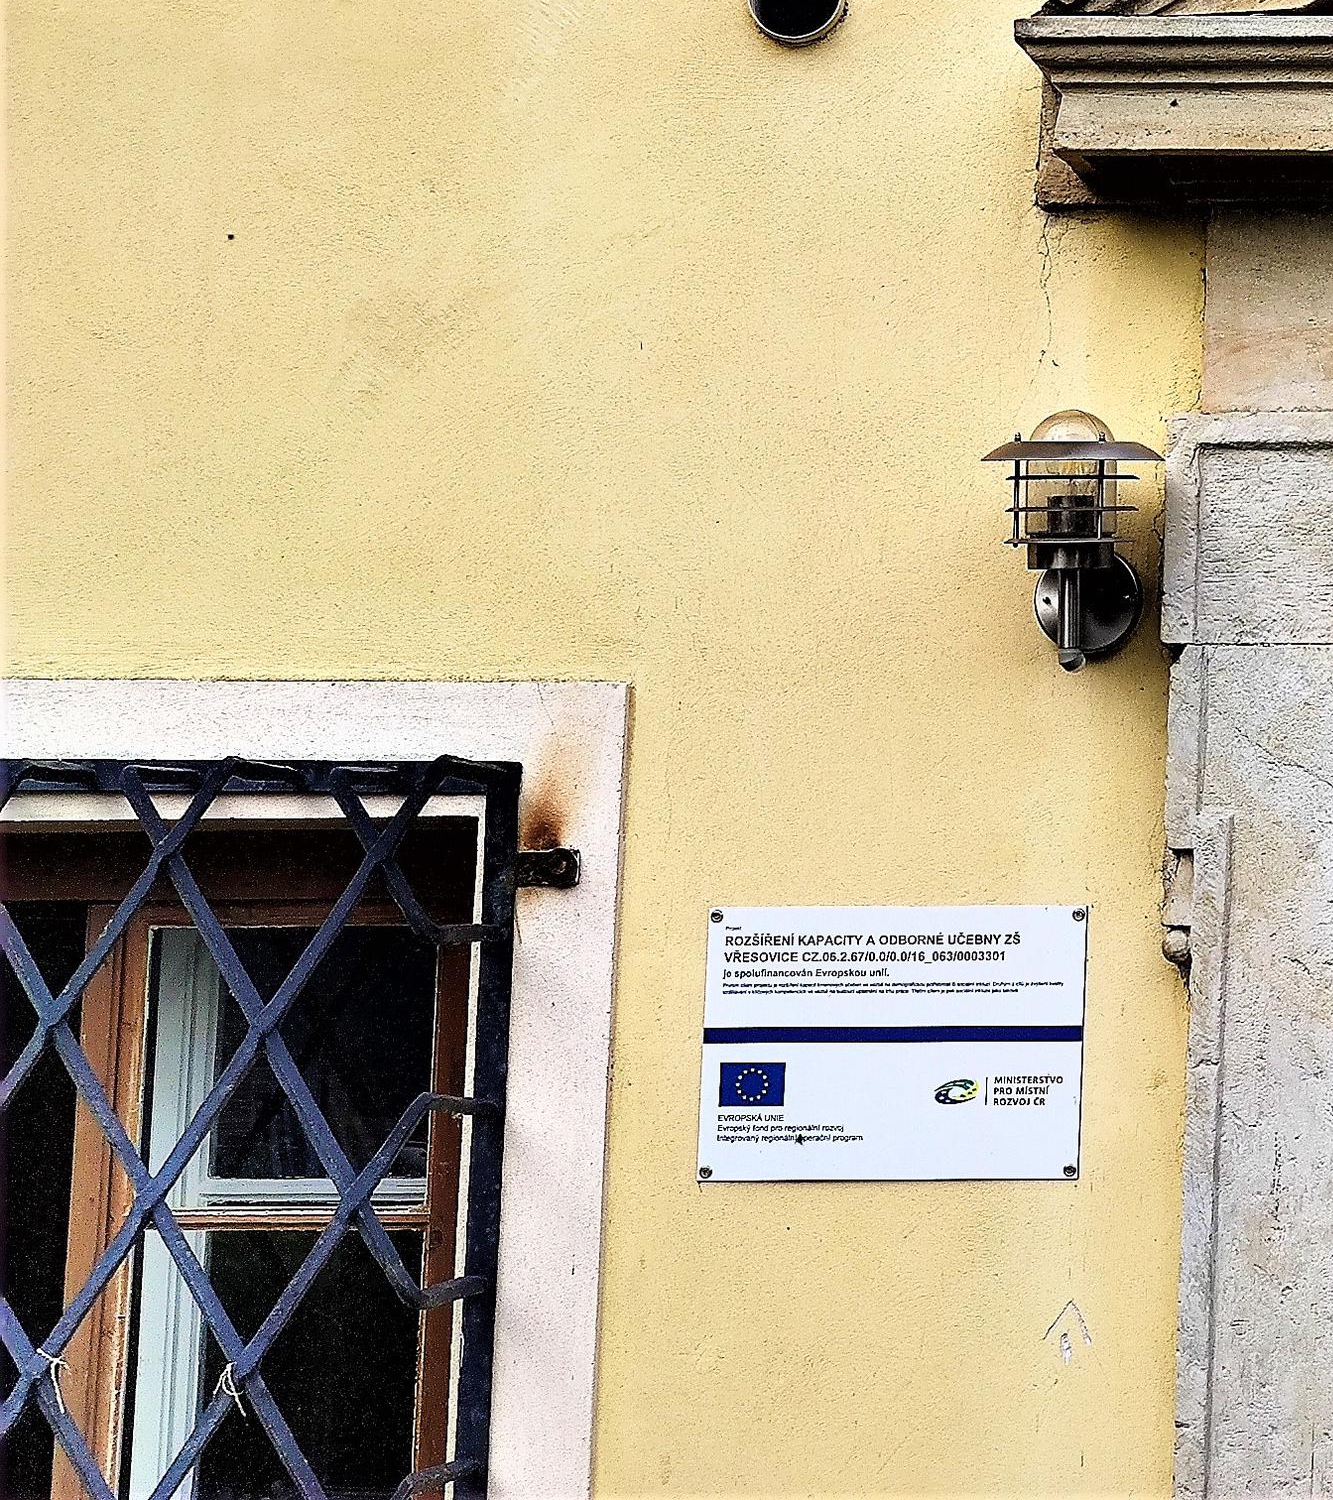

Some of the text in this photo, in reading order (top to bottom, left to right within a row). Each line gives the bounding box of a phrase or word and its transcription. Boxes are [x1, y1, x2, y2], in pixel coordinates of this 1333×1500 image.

[725, 931, 1021, 947] ROZŠÍŘENÍ KAPACITY A ODBORNÉ UČEBNY ZŠ
[724, 949, 798, 963] VŘESOVICE
[734, 968, 813, 980] spolufinancován
[815, 968, 867, 980] Evropskou
[993, 1075, 1064, 1085] MINISTERSTVO
[993, 1085, 1050, 1095] PRO MÍSTNÍ
[993, 1096, 1046, 1106] ROZVOJ ČR
[717, 1113, 785, 1122] EVROPSKÁ UNIE
[717, 1124, 751, 1133] Evropský
[752, 1124, 769, 1132] fond
